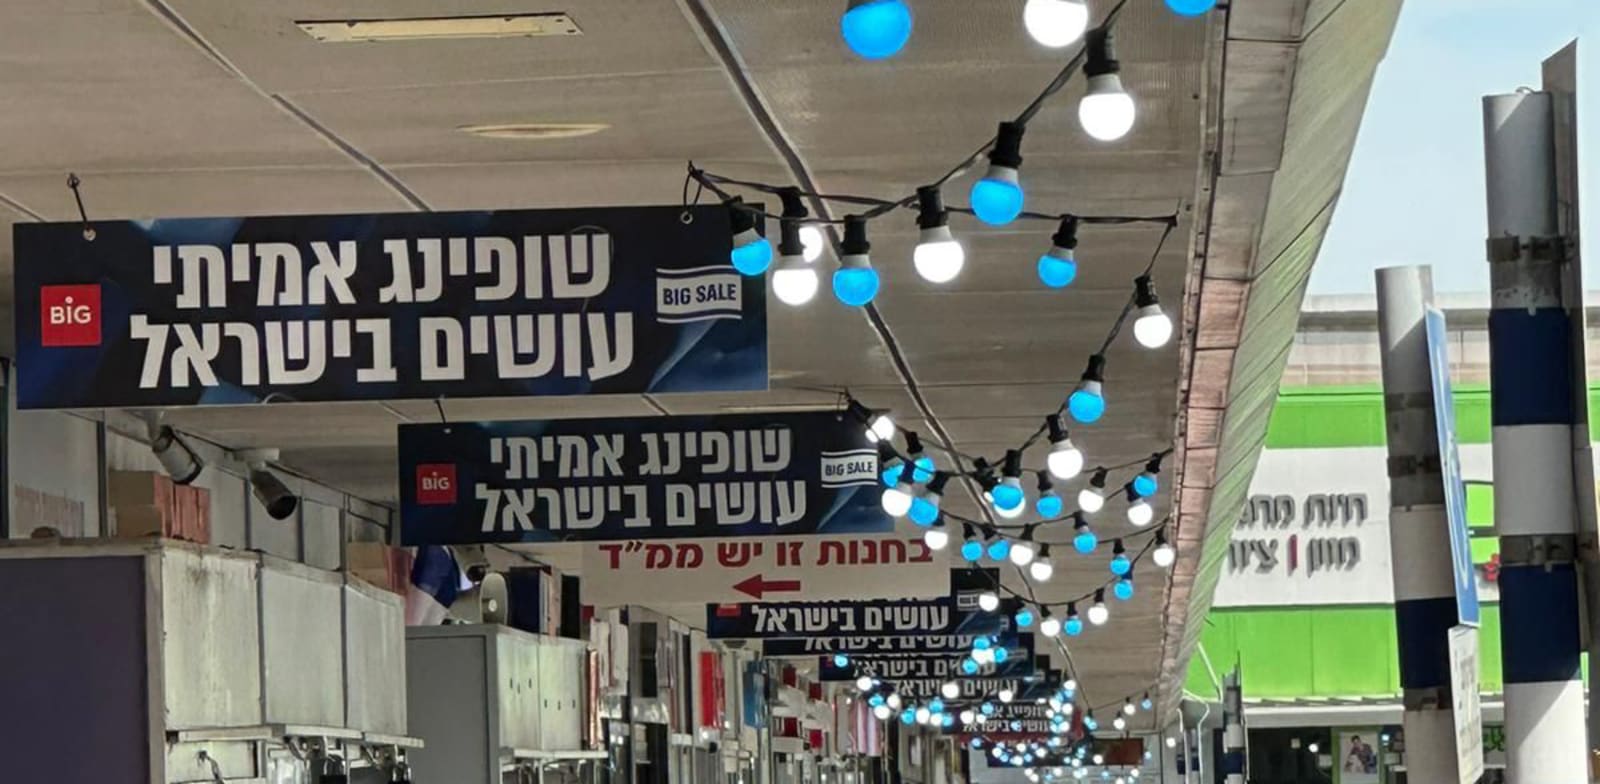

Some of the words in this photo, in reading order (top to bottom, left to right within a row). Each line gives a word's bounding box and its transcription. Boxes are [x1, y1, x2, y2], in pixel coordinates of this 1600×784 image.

[152, 239, 357, 309] אמיתי
[378, 232, 611, 305] שופינג
[663, 288, 691, 306] BIG
[696, 283, 737, 303] SALE
[130, 315, 398, 389] בישראל
[419, 311, 635, 382] עושים
[490, 434, 625, 480] אמיתי
[639, 428, 791, 476] שופינג
[825, 464, 844, 476] BIG
[847, 461, 873, 474] SALE
[475, 483, 651, 532] בישראל
[666, 480, 807, 527] עושים
[1237, 494, 1296, 530] מח
[717, 543, 763, 568] יש
[776, 540, 802, 567] זו
[816, 539, 934, 566] בחנות
[751, 604, 856, 633] בישראל
[864, 604, 949, 632] עושים
